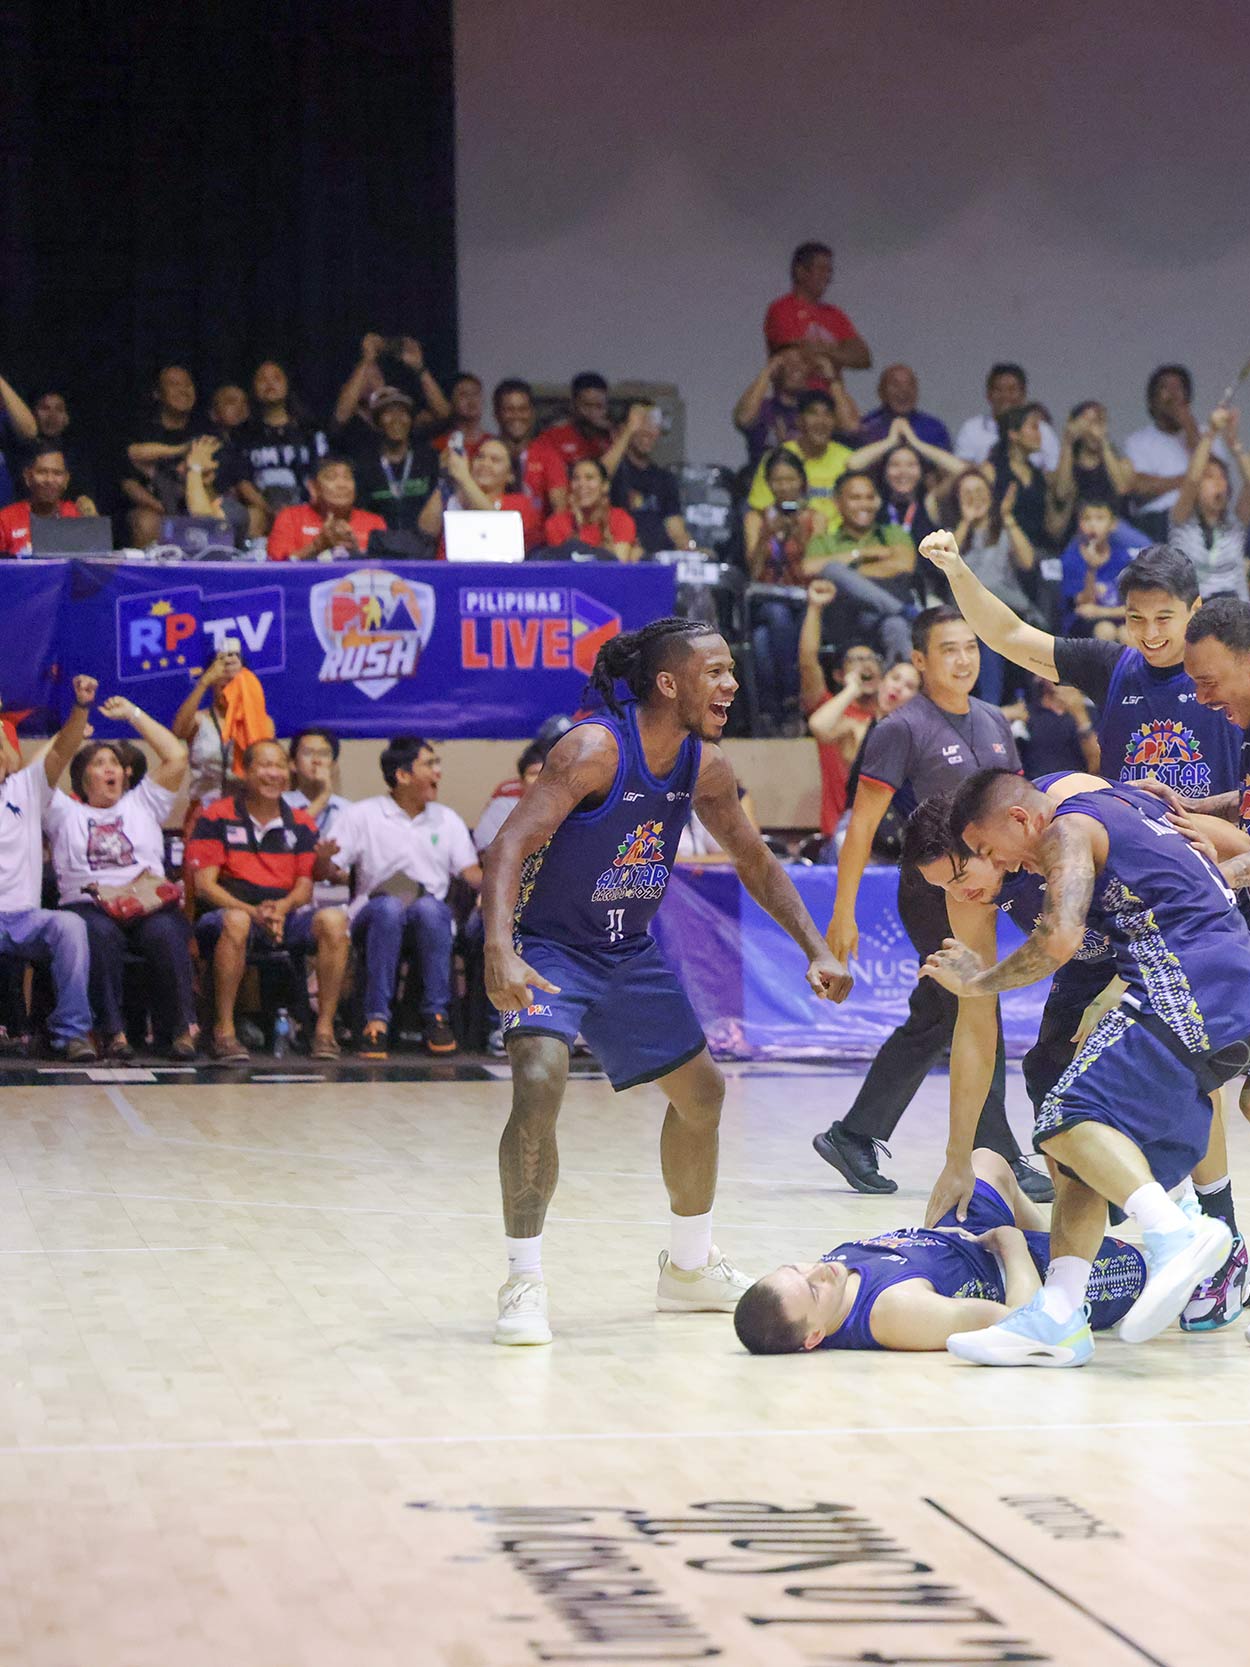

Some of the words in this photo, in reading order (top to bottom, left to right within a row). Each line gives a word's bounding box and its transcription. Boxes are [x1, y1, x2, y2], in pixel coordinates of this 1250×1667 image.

[466, 591, 562, 613] PILIPINAS
[318, 637, 420, 683] RUSH
[461, 618, 570, 670] LIVE
[848, 958, 920, 986] NUS
[628, 1500, 936, 1575] Salle
